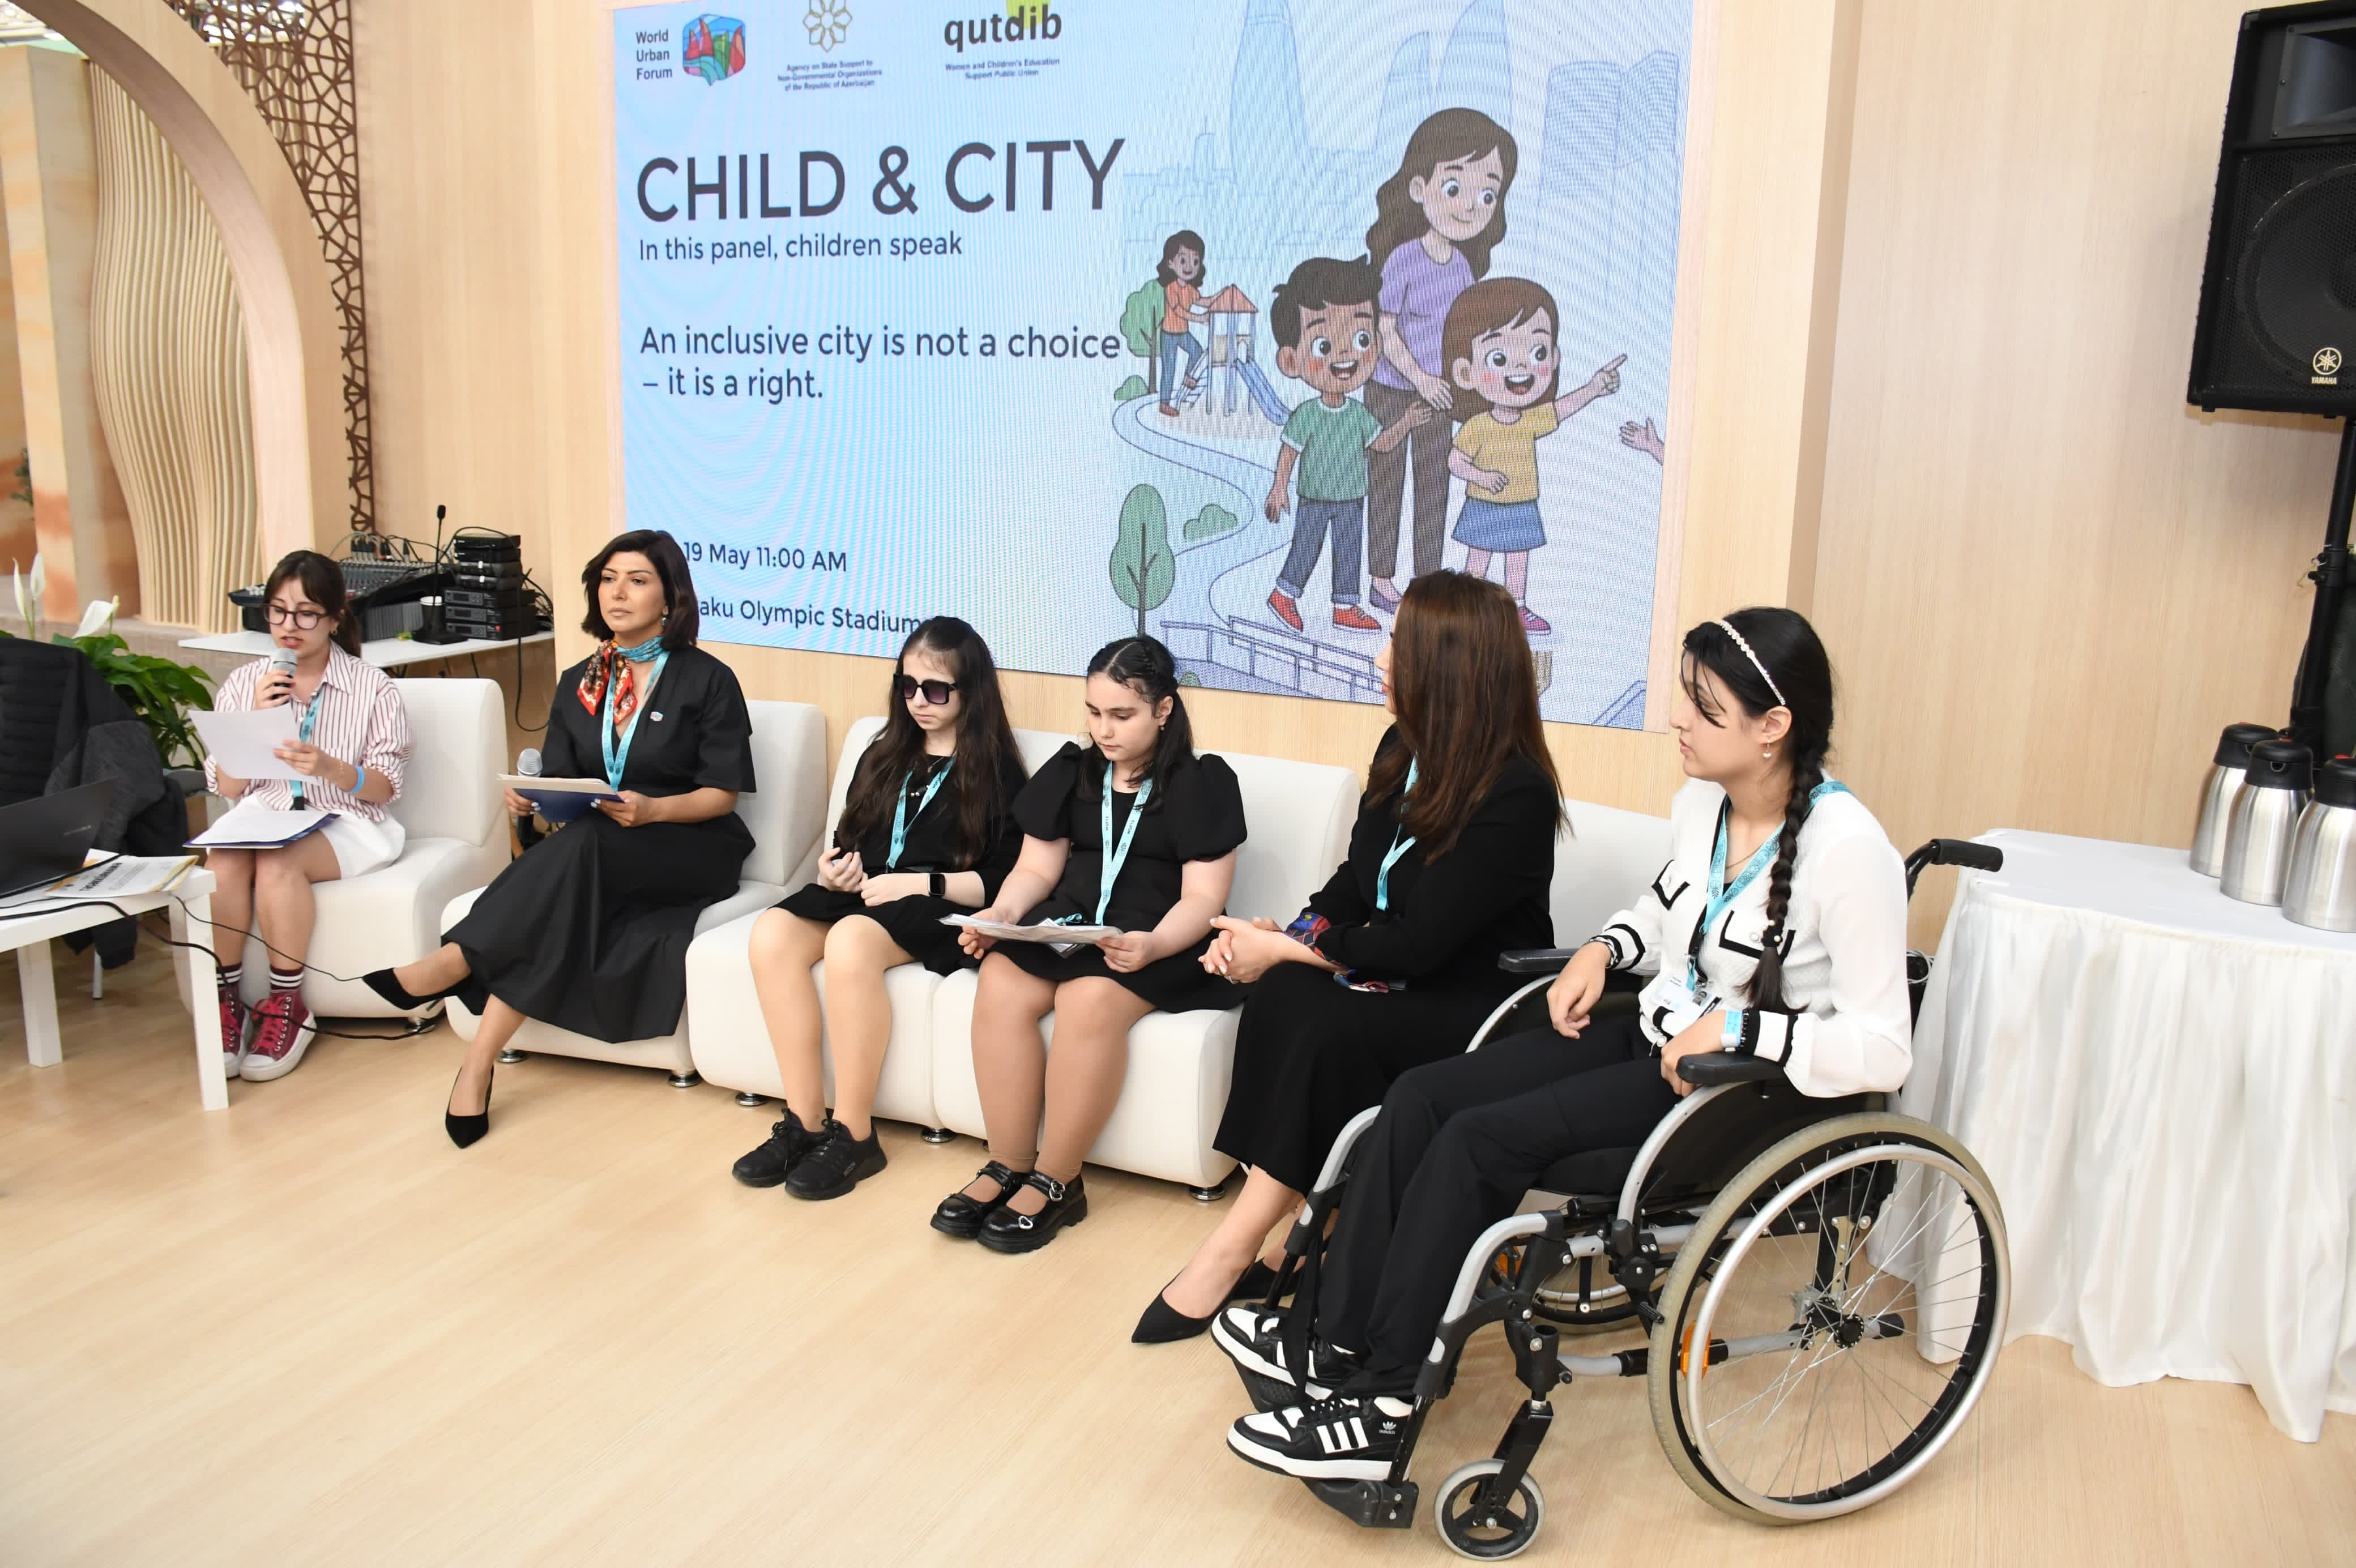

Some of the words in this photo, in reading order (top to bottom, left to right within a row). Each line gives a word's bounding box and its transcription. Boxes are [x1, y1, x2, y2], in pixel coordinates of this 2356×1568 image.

[635, 29, 669, 44] World
[944, 5, 1062, 53] qutdib
[636, 49, 669, 62] Urban
[786, 64, 809, 72] Agency
[839, 60, 865, 69] Support
[987, 59, 1022, 69] Children's
[1024, 58, 1060, 67] Education
[637, 67, 673, 80] Forum
[964, 71, 992, 80] Support
[804, 81, 831, 91] Republic
[840, 79, 875, 89] Azerbaijan
[638, 151, 845, 221] CHILD
[873, 146, 918, 215] &
[946, 139, 1125, 213] CITY
[640, 240, 658, 260] In
[665, 237, 703, 259] this
[712, 236, 778, 264] panel,
[786, 233, 881, 257] children
[890, 231, 962, 261] speak
[641, 327, 676, 355] An
[686, 326, 808, 356] inclusive
[818, 325, 873, 363] city
[884, 325, 904, 356] is
[917, 327, 968, 357] not
[980, 334, 996, 357] a
[1008, 326, 1120, 358] choice
[669, 367, 686, 395] it
[695, 367, 714, 396] is
[724, 375, 738, 396] a
[749, 368, 823, 405] right.
[2311, 376, 2337, 384] YAMAHA
[684, 542, 702, 561] 19
[710, 544, 750, 570] May
[757, 547, 805, 569] 11:00
[812, 551, 847, 571] AM
[700, 597, 733, 618] aku
[740, 600, 825, 629] Olympic
